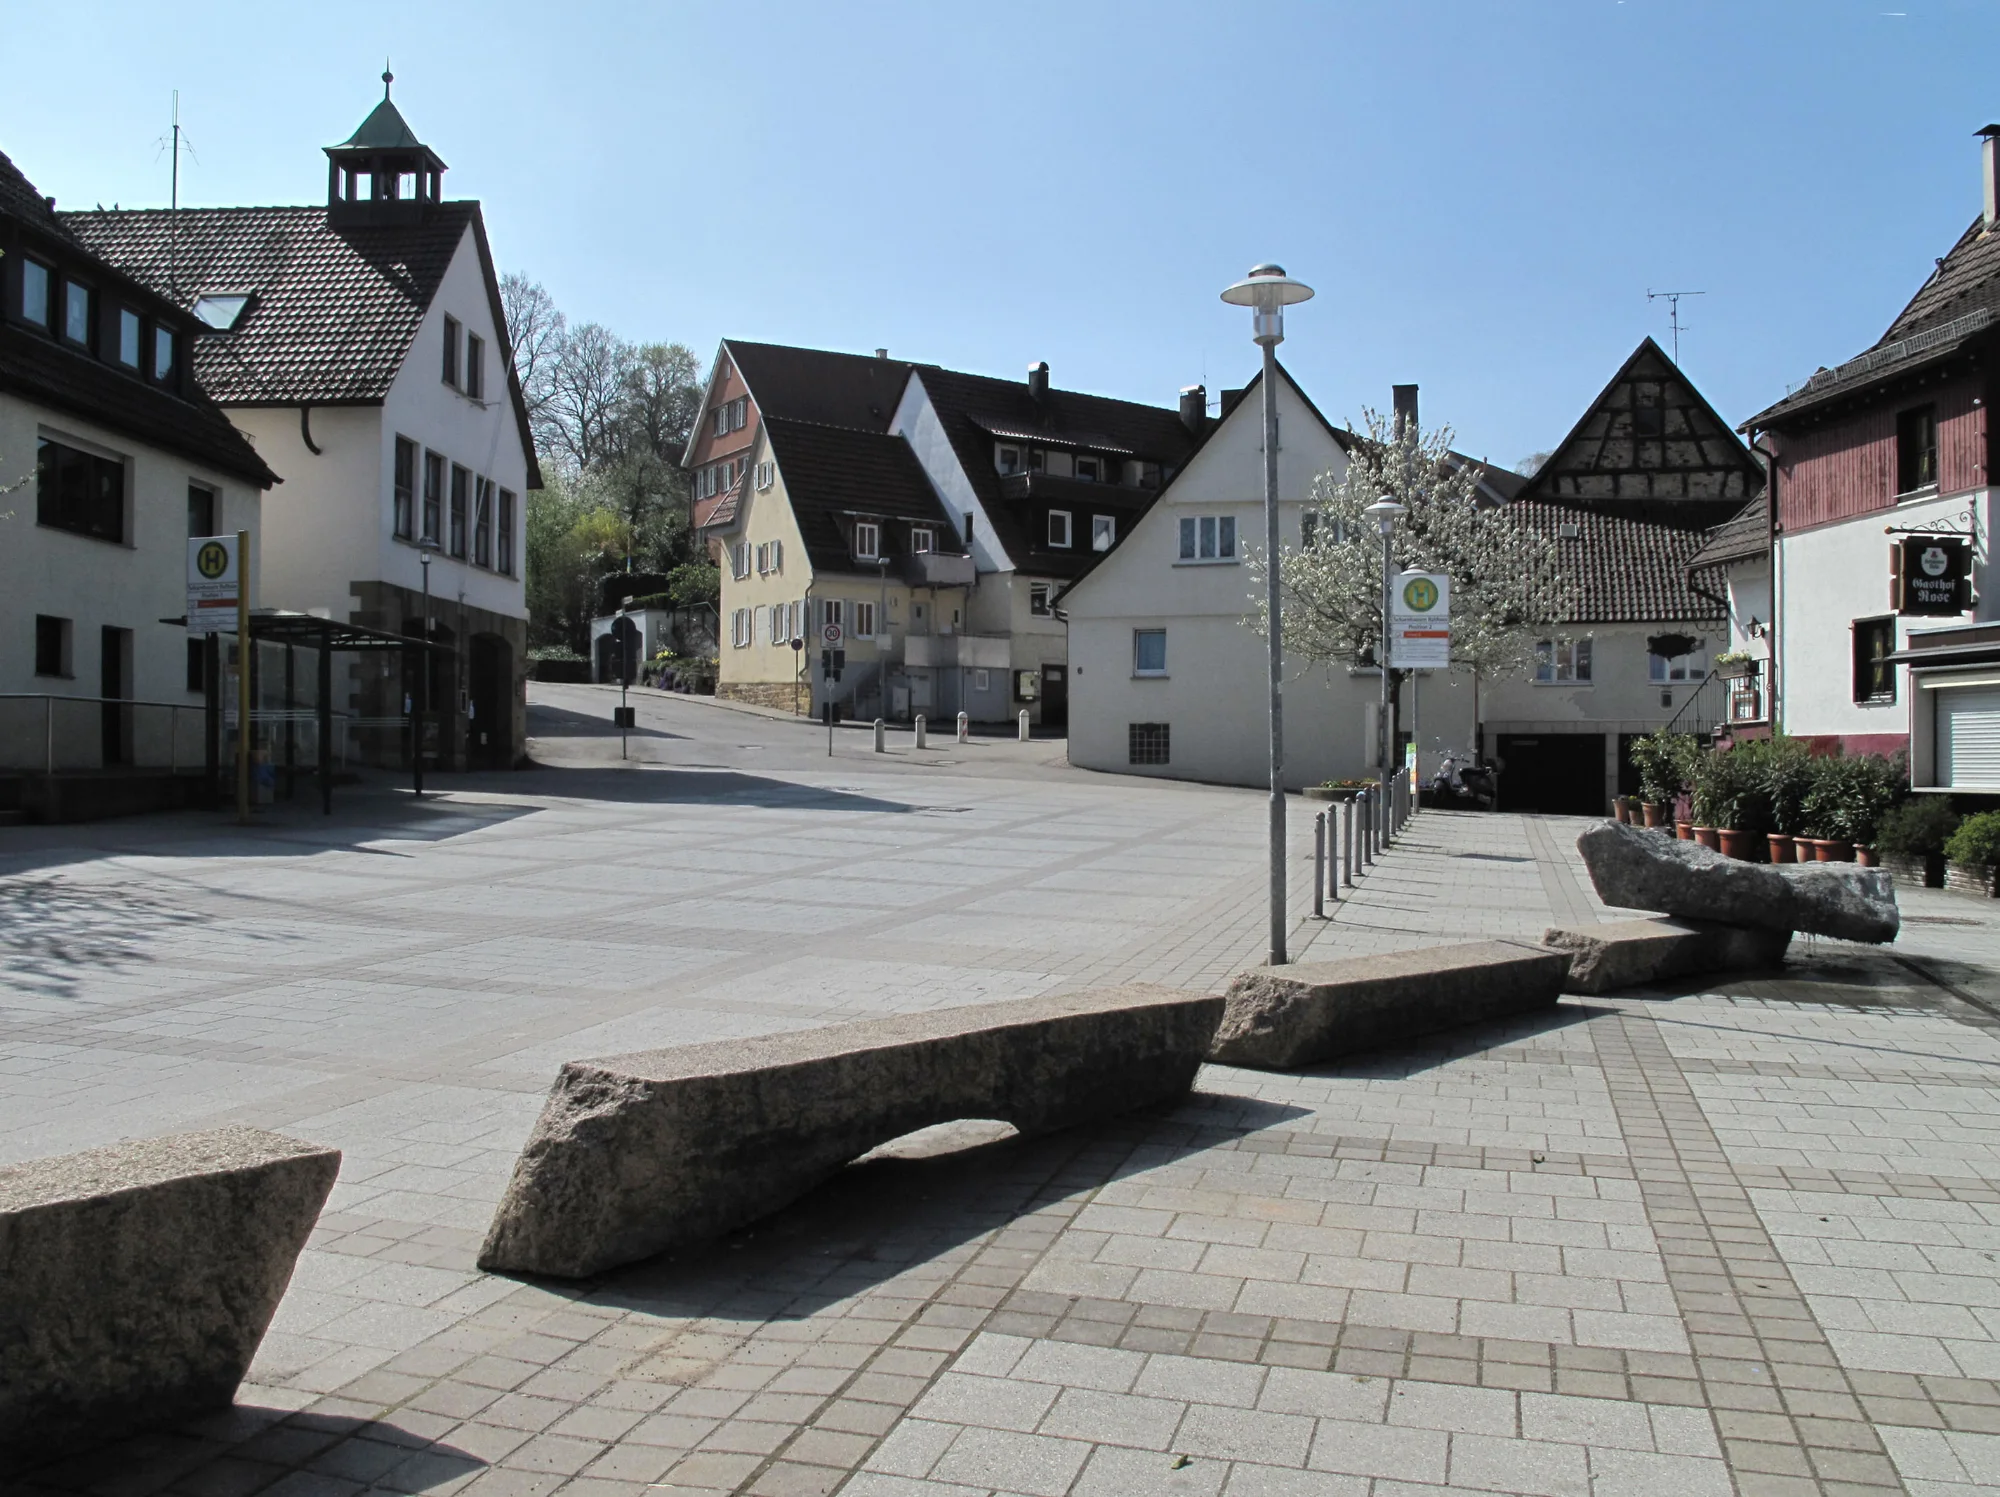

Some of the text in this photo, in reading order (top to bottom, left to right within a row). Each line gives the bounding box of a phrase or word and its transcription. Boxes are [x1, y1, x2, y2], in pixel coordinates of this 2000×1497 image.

[205, 550, 220, 571] H
[1912, 578, 1956, 592] Gasthof
[1413, 586, 1429, 605] H
[1917, 591, 1951, 603] Rose
[827, 629, 837, 638] 30
